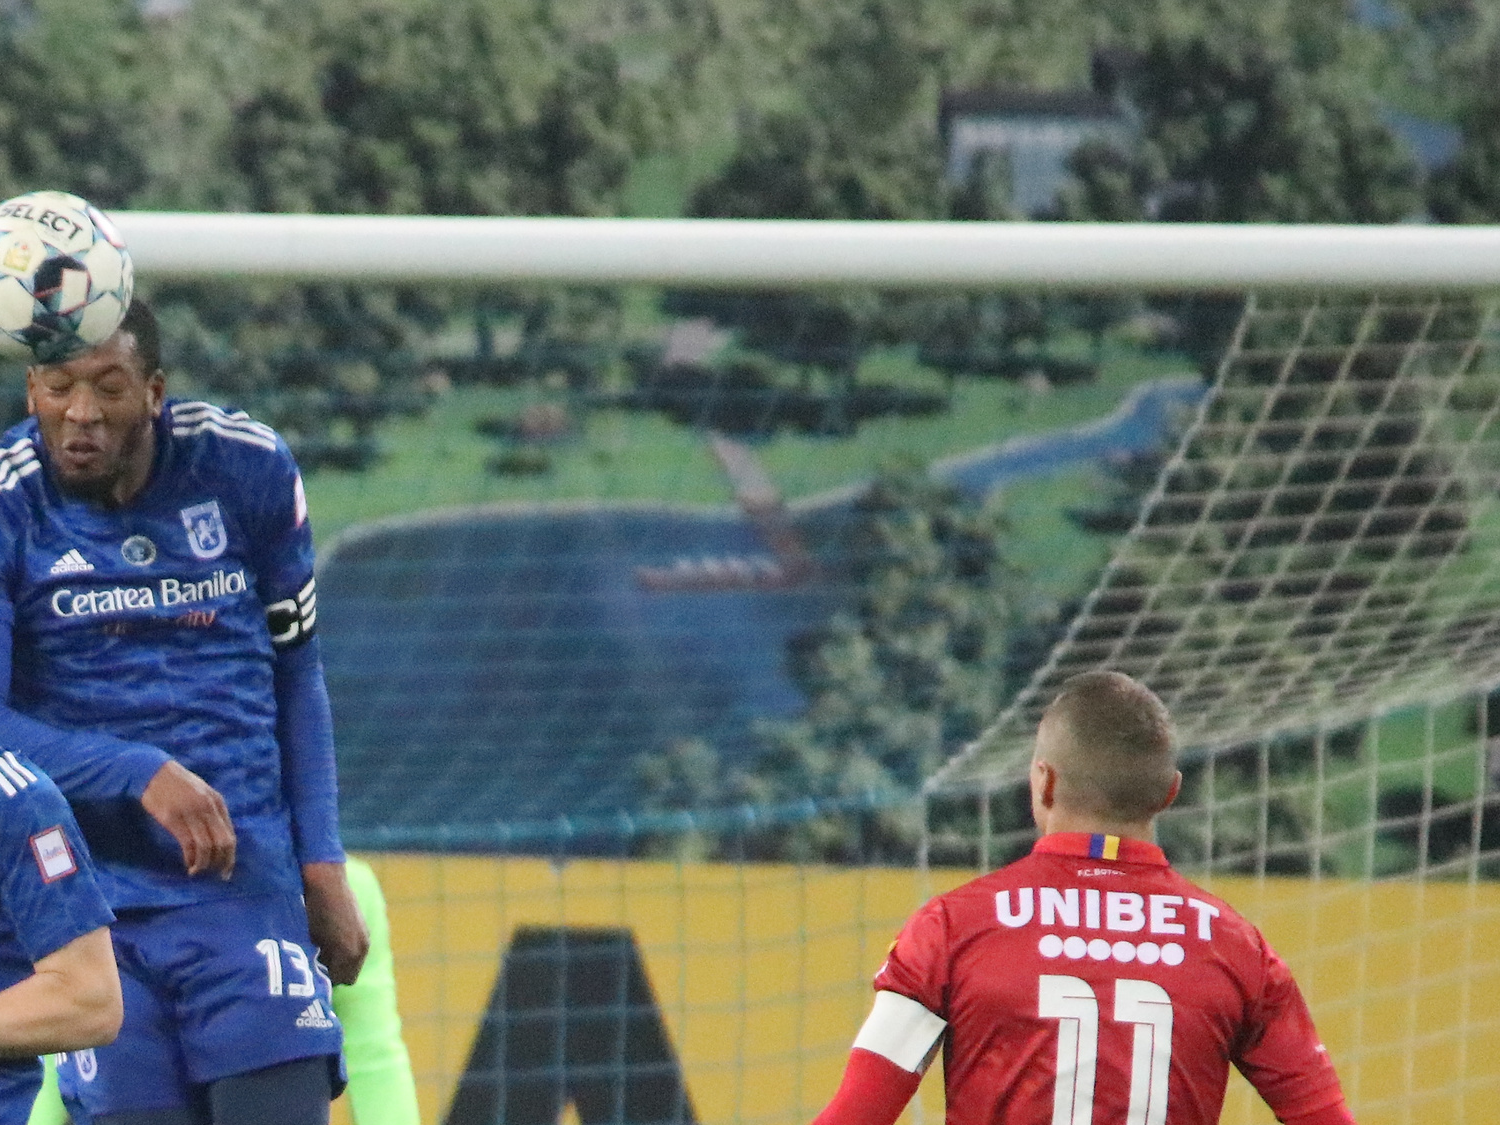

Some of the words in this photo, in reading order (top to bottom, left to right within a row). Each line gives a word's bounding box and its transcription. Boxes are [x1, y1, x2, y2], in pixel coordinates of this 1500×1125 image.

[51, 587, 155, 618] Cetatea
[995, 886, 1220, 941] UNIBET
[255, 938, 315, 998] 13
[296, 1016, 334, 1029] adidas
